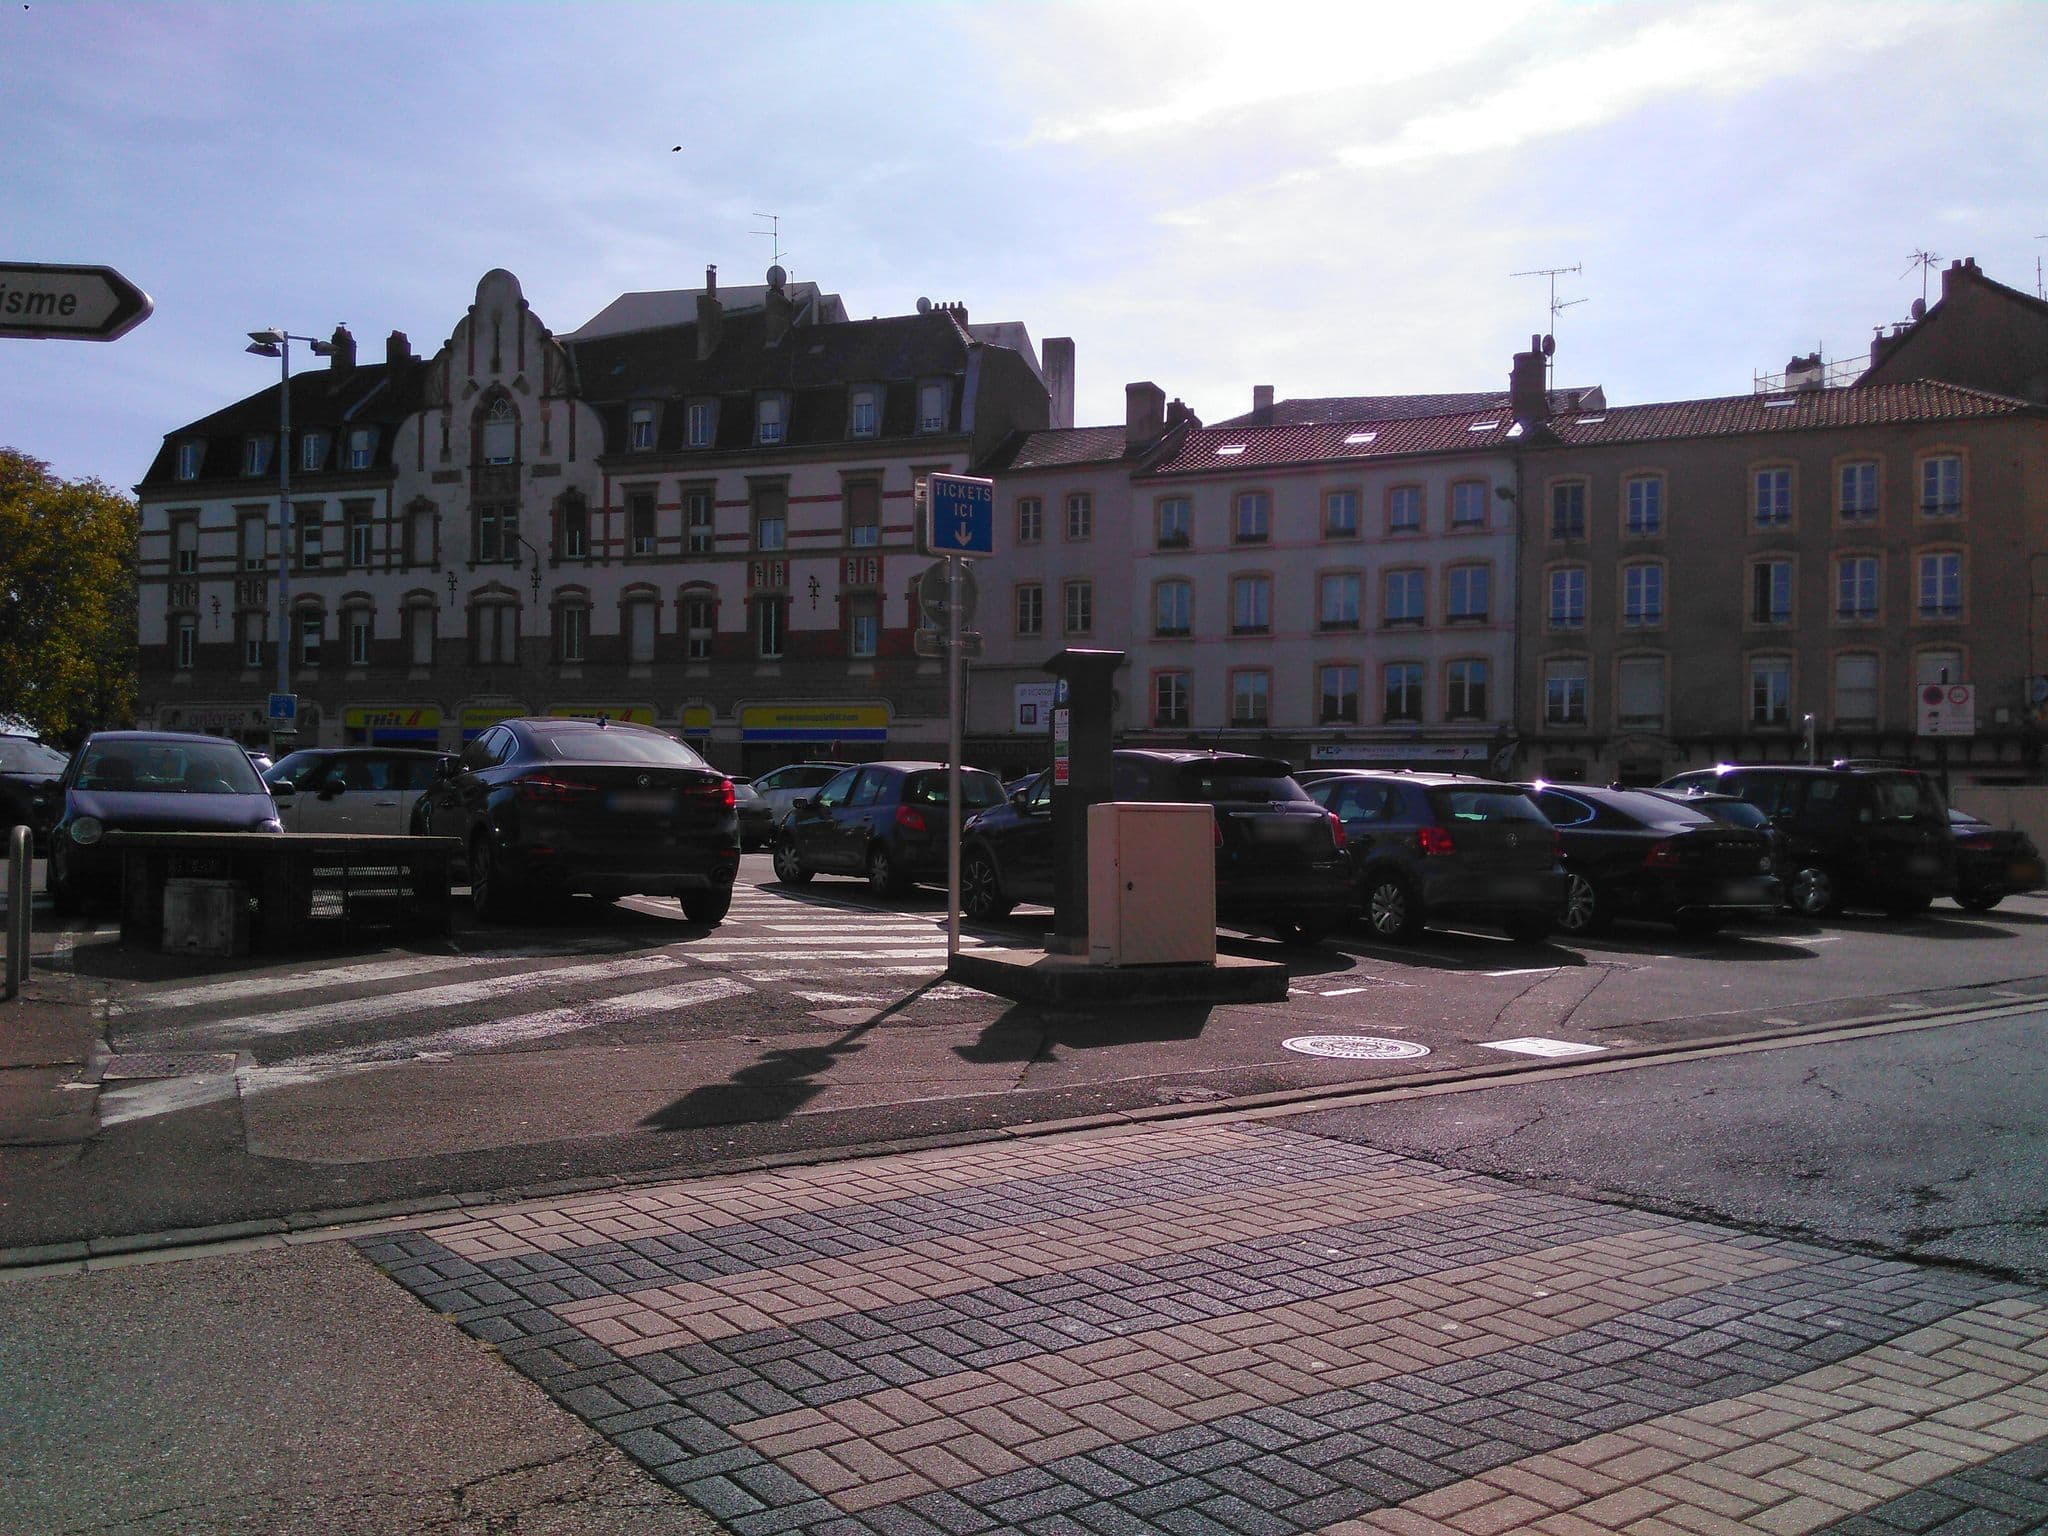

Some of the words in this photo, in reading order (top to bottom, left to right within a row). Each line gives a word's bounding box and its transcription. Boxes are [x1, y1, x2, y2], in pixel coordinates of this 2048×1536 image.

[0, 284, 77, 315] isme
[935, 481, 992, 502] TICKETS
[954, 503, 973, 517] ICI
